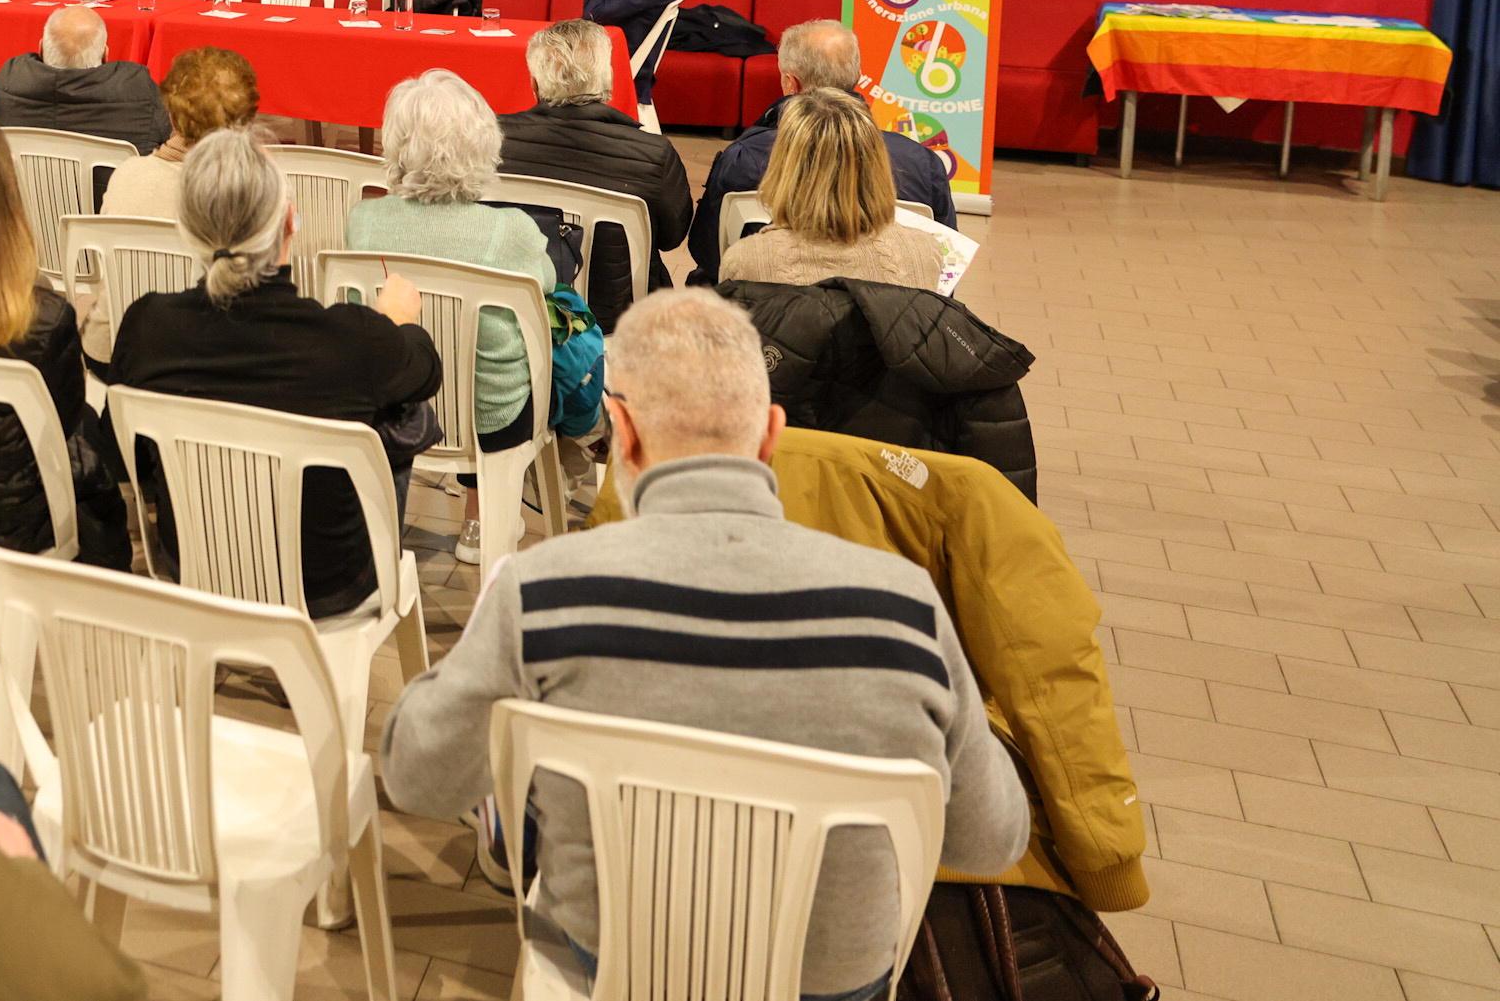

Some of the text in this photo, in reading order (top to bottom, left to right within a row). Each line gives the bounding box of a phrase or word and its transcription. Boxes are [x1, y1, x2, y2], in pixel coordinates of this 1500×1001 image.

[937, 0, 988, 20] urbana
[869, 84, 984, 114] BOTTEGONE
[946, 326, 975, 356] NOZONE
[881, 448, 916, 476] NORTH
[900, 450, 919, 465] THE
[885, 461, 911, 481] FACE
